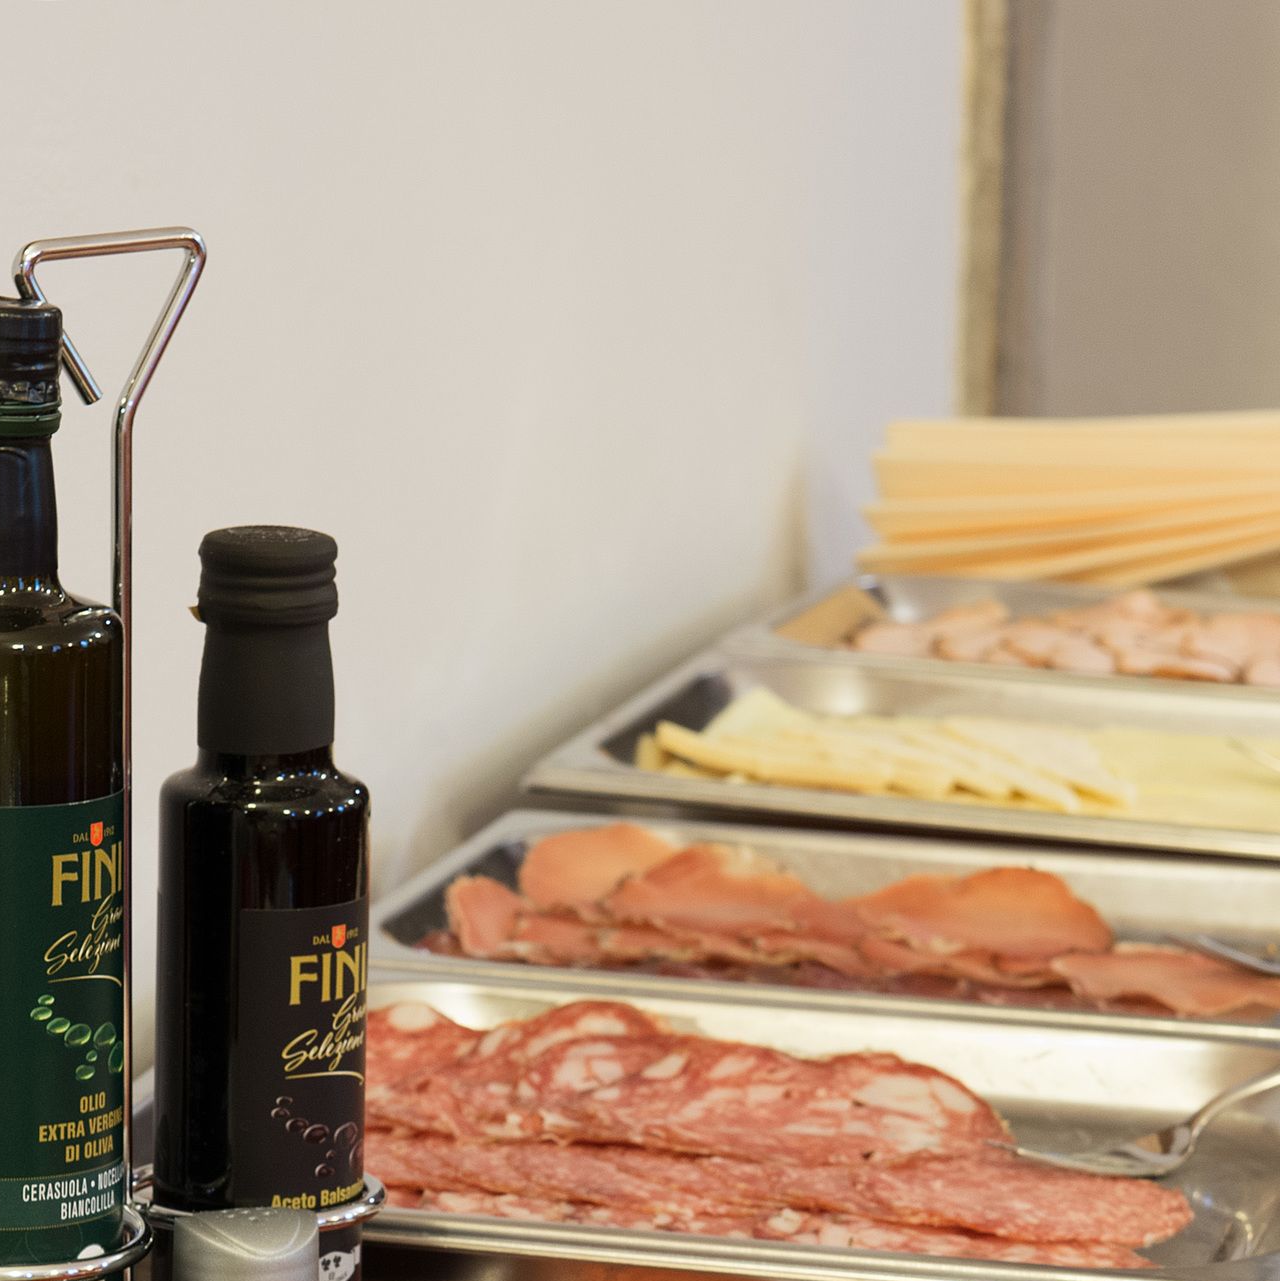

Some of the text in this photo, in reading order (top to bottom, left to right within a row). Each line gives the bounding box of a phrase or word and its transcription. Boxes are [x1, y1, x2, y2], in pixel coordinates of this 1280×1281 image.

[73, 832, 89, 843] DAL
[51, 841, 122, 907] FINI
[91, 893, 123, 944] Gra
[44, 930, 121, 974] Selezion
[313, 935, 330, 946] DAL
[289, 941, 367, 1006] FINI
[332, 993, 366, 1042] Gra
[282, 1029, 365, 1072] Selezion
[80, 1091, 106, 1114] OLIO
[39, 1119, 86, 1143] EXTRA
[65, 1134, 114, 1163] DI OLIVA
[22, 1177, 89, 1203] CERASUOLA
[61, 1189, 115, 1221] BIANCOLILLA
[272, 1192, 317, 1210] Aceto
